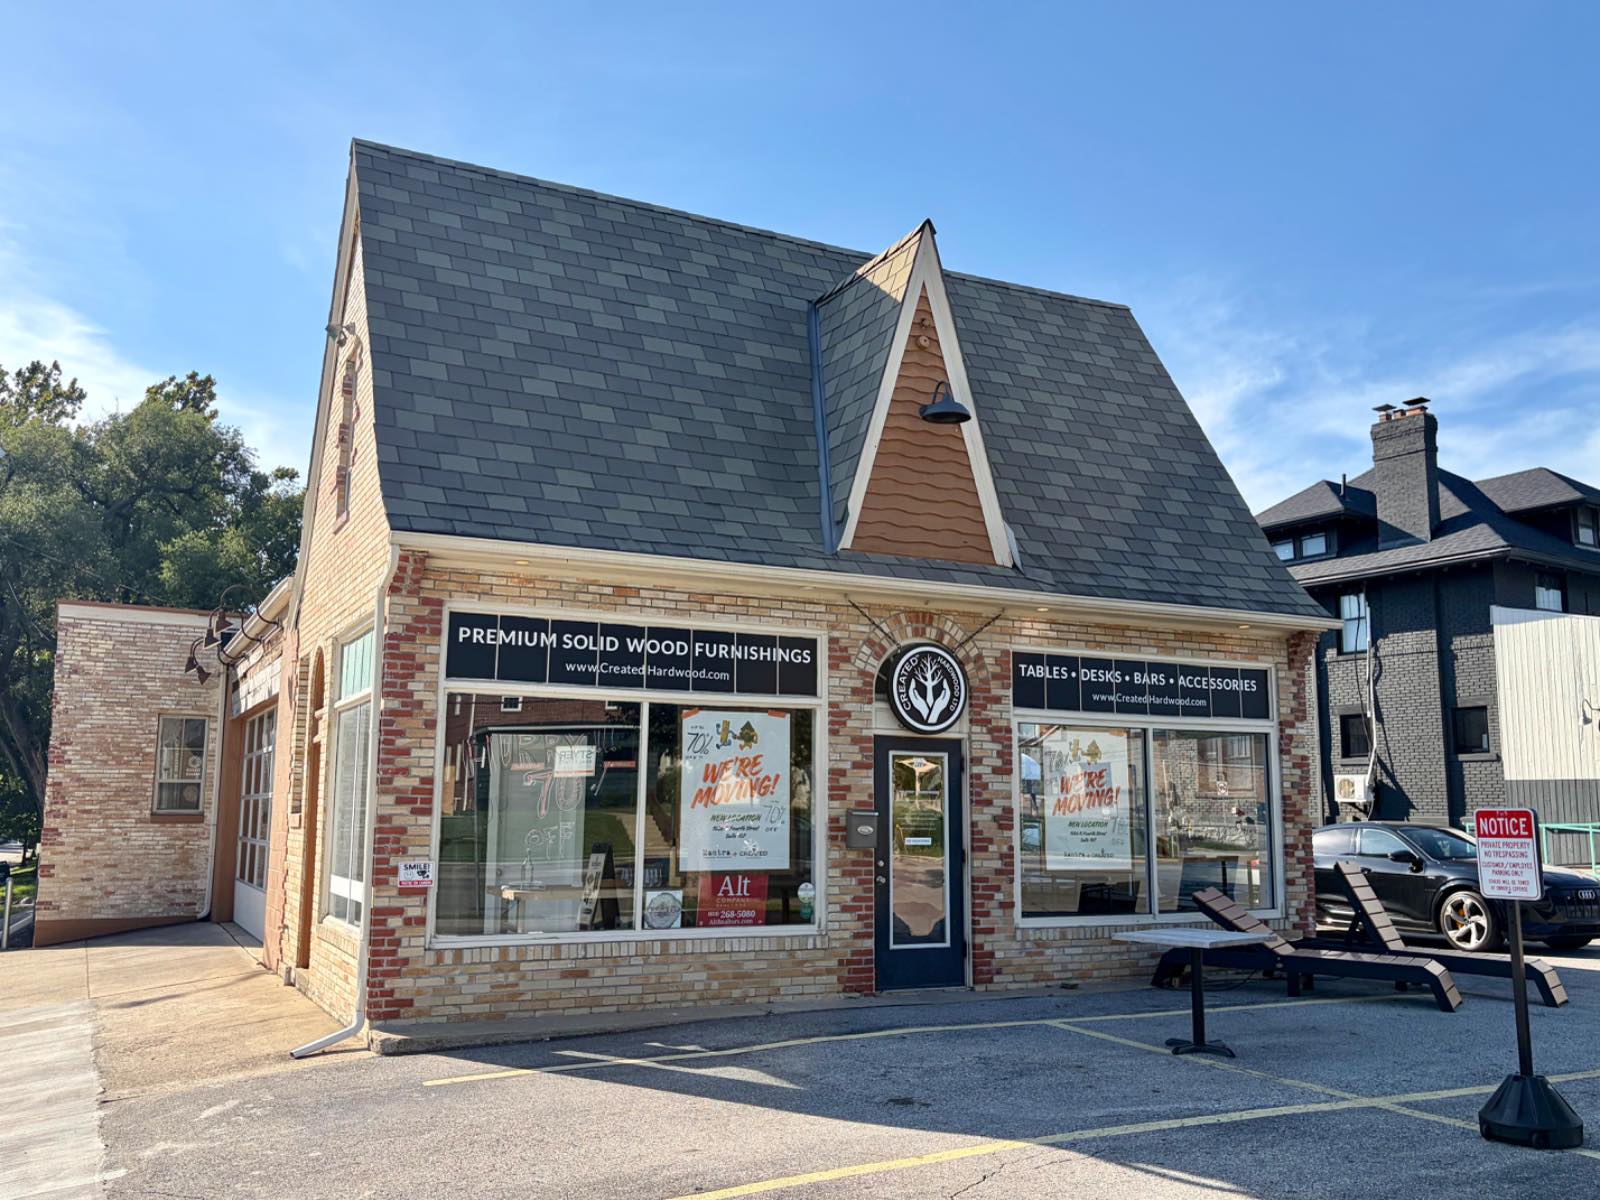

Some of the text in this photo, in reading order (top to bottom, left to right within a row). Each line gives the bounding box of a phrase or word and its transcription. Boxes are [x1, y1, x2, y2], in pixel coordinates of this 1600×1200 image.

[458, 627, 812, 664] PREMIUM SOLID WOOD FURNISHINGS
[896, 656, 919, 711] CREATED
[1019, 664, 1257, 691] TABLES DESKS BARS ACCESSORIES
[702, 754, 764, 784] WE'RE
[1060, 768, 1108, 794] WE'RE
[690, 773, 781, 809] MOVING!
[1051, 786, 1121, 817] MOVING!
[1479, 816, 1529, 836] NOTICE
[1484, 850, 1528, 859] NO TRESPASSING
[1502, 842, 1530, 850] PROPERTY
[403, 863, 430, 872] SMILE!
[717, 875, 751, 897] Alt
